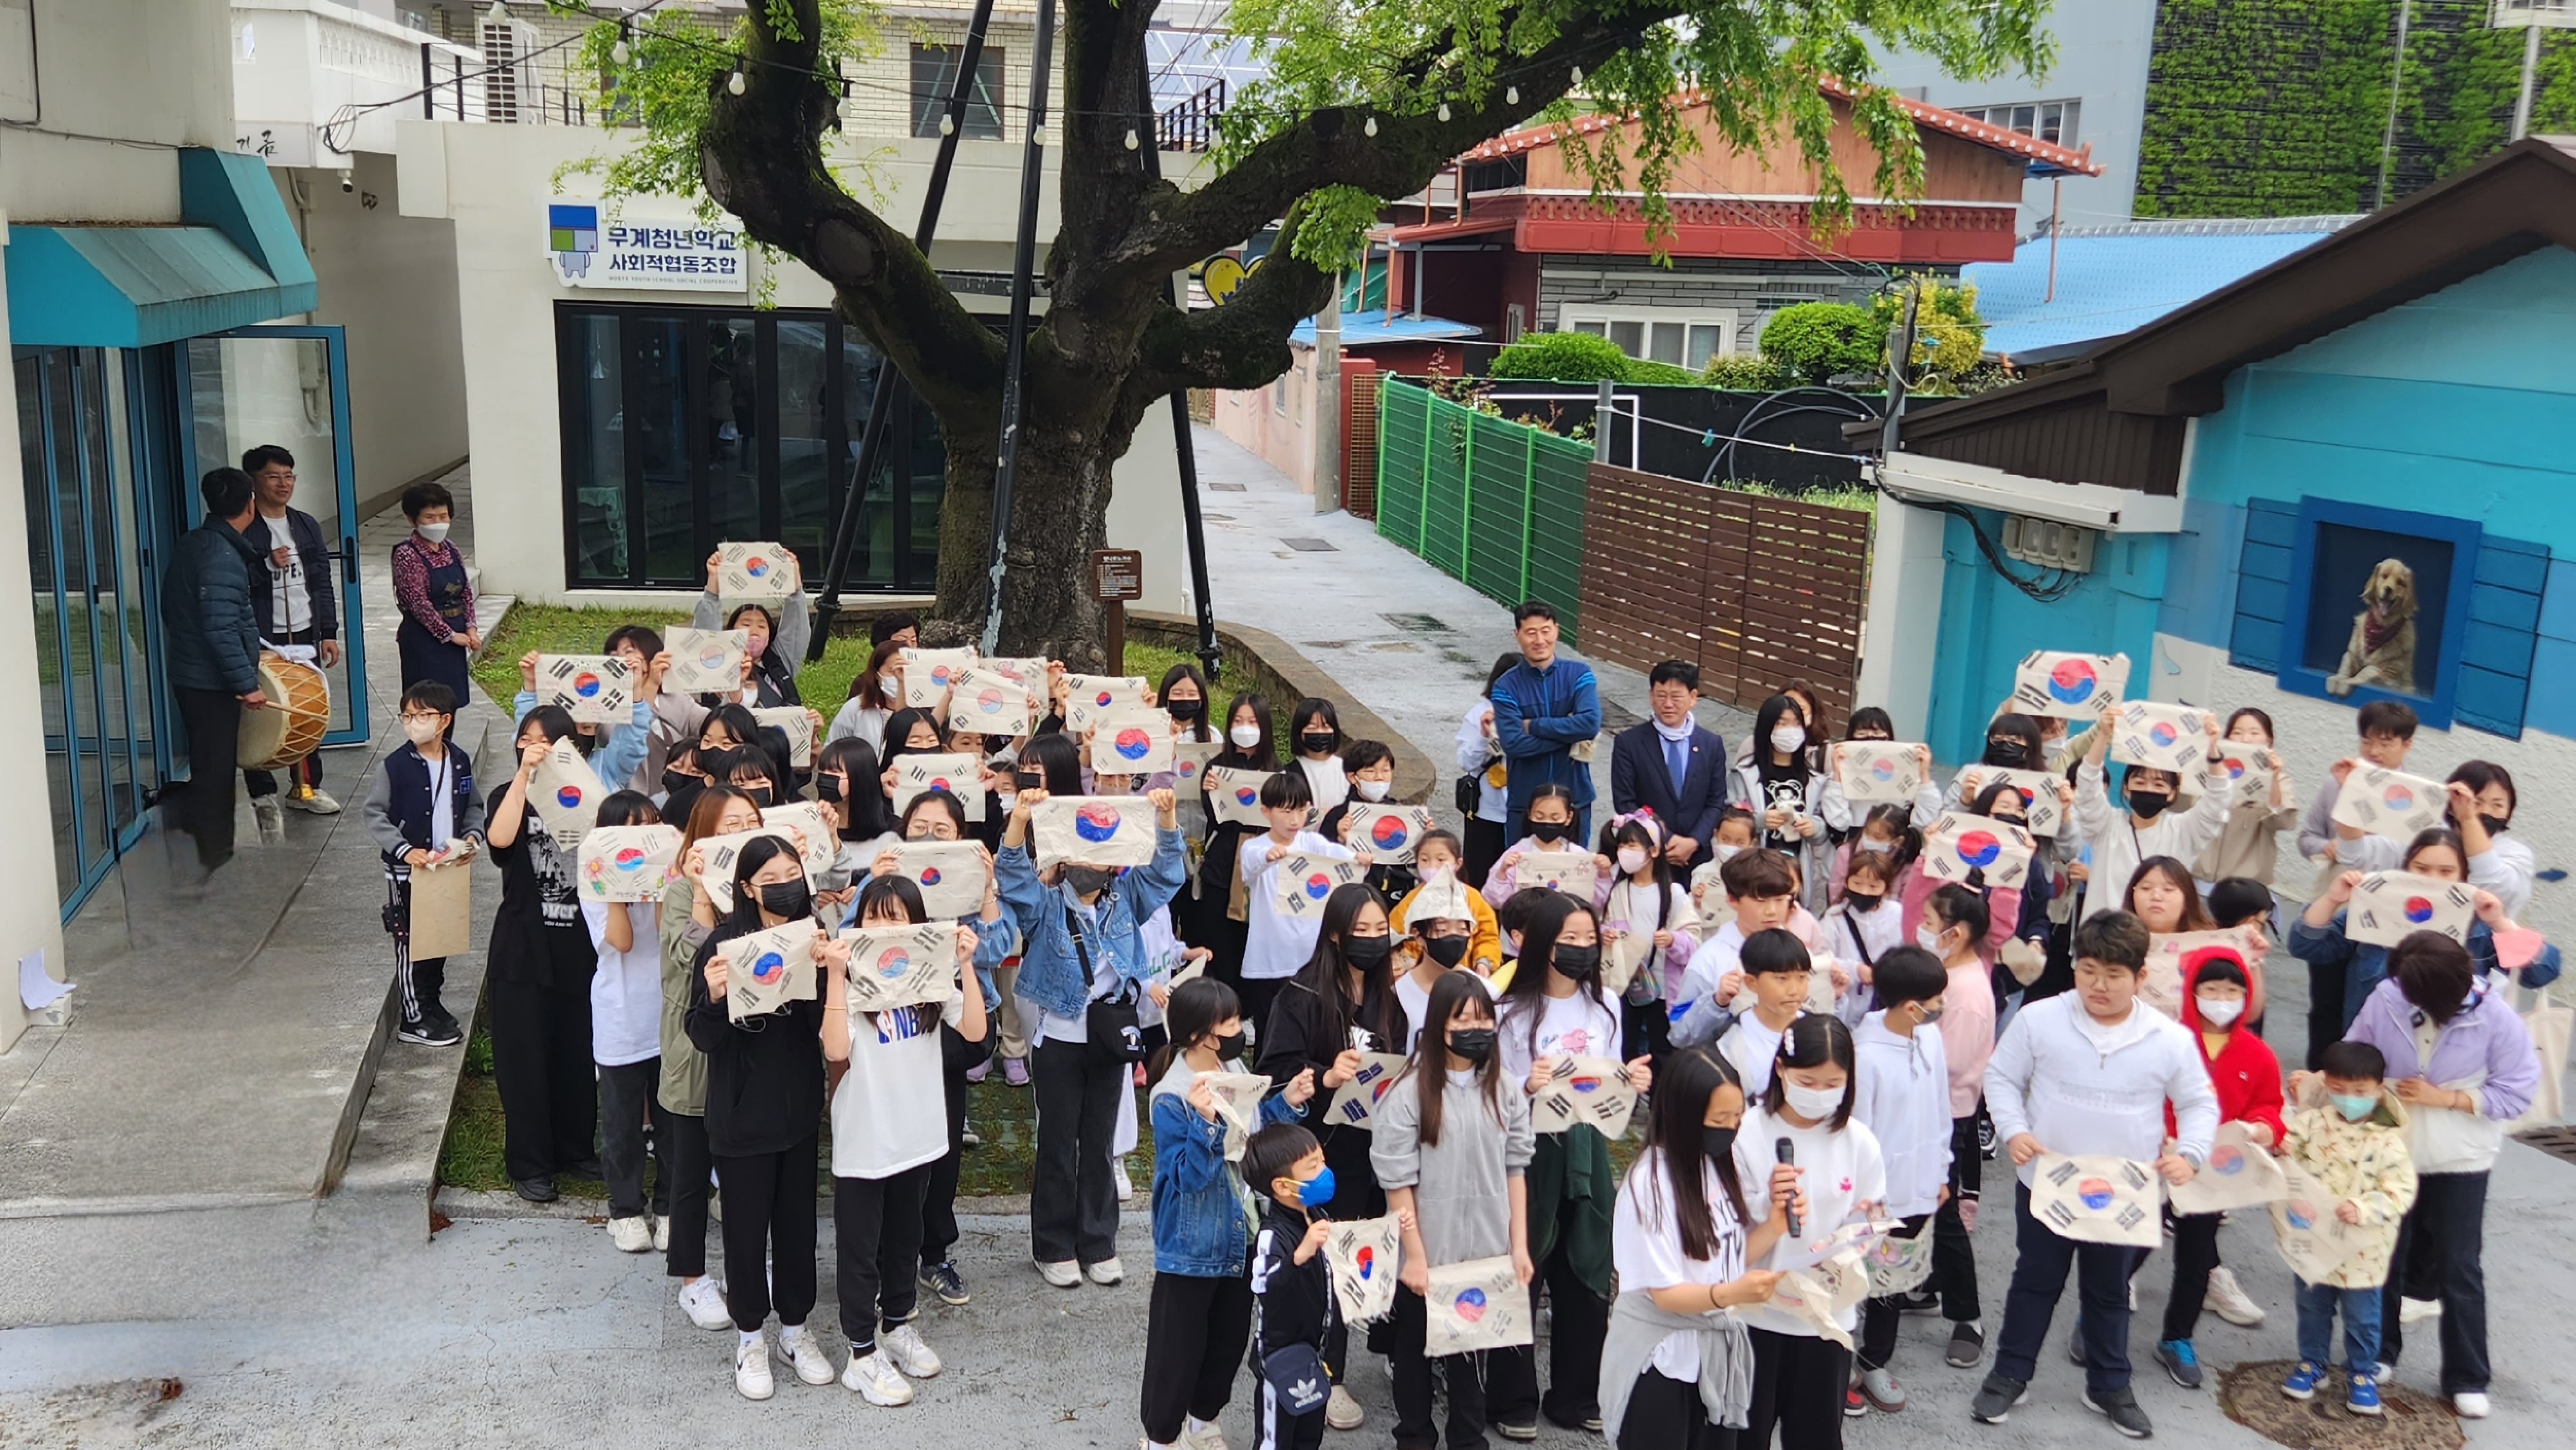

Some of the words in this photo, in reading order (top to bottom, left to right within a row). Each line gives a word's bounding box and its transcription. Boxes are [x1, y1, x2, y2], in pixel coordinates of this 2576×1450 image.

[608, 227, 737, 250] 무계청년학교
[609, 254, 737, 274] 사회적협동조합
[892, 1004, 920, 1040] NB
[1295, 1391, 1322, 1408] adidas
